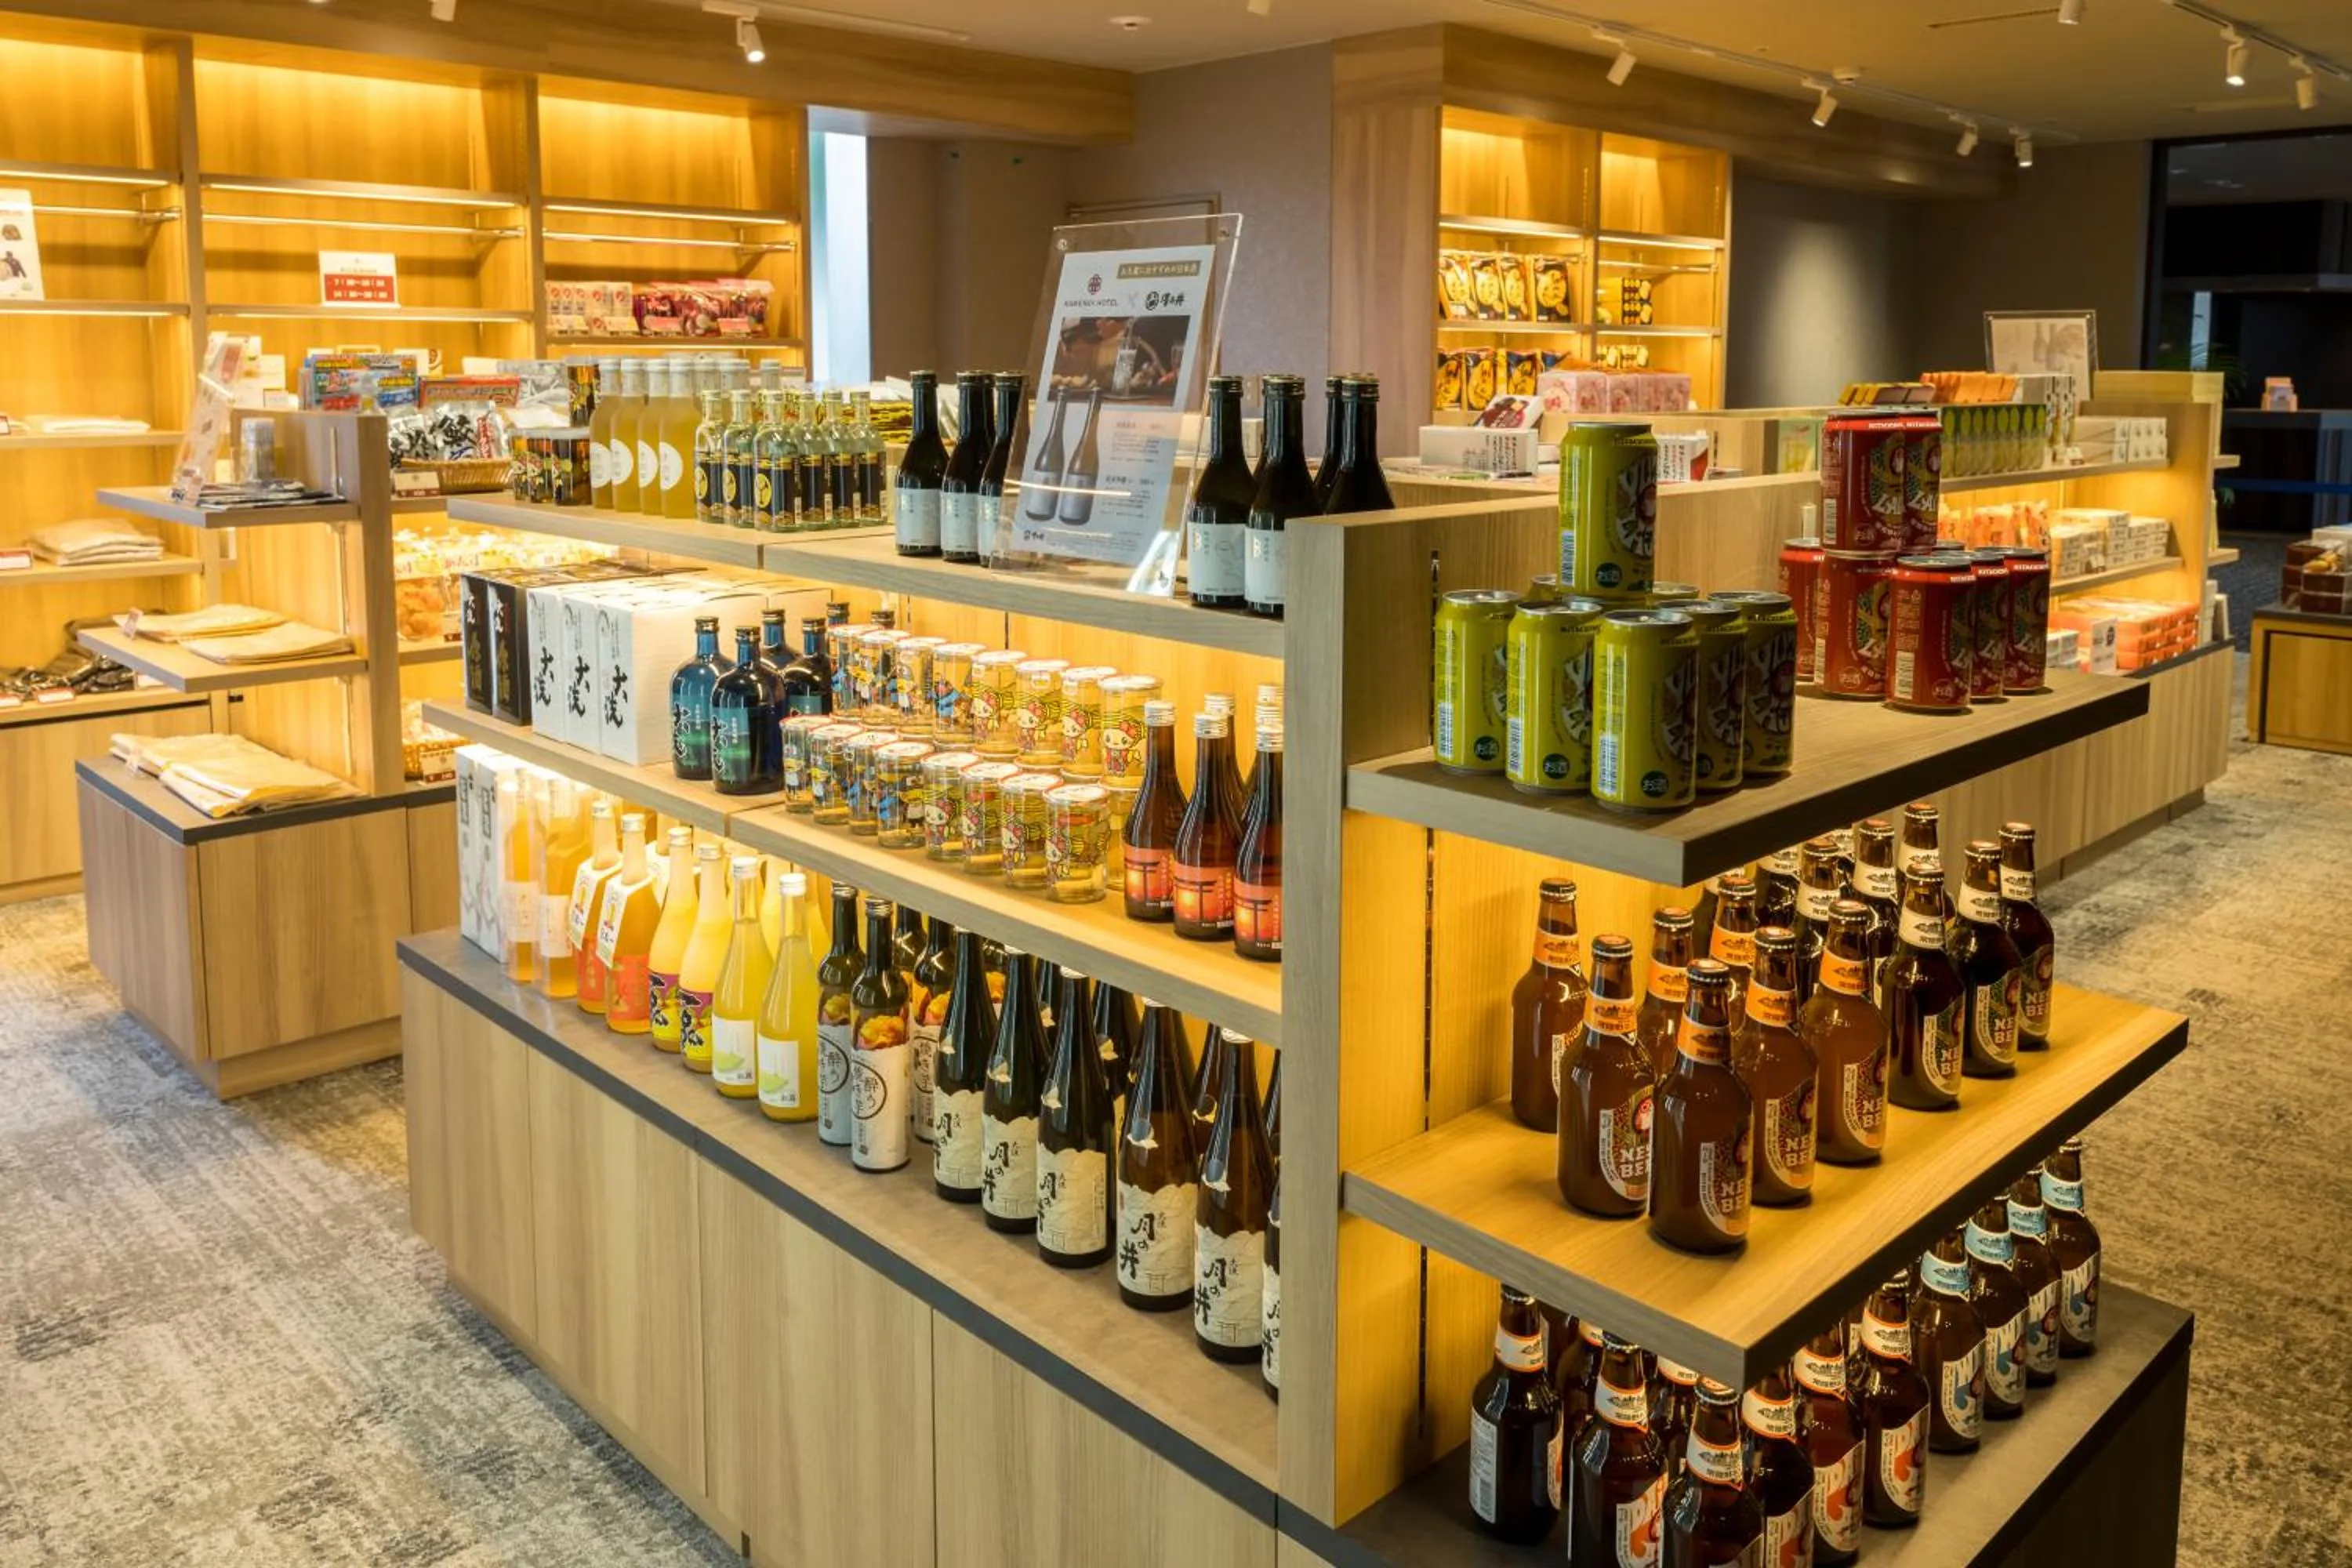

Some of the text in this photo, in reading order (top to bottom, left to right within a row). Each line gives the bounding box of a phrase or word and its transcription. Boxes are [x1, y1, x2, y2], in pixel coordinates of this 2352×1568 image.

[1120, 1213, 1155, 1279] 月の井
[1195, 1257, 1227, 1326] 月の井
